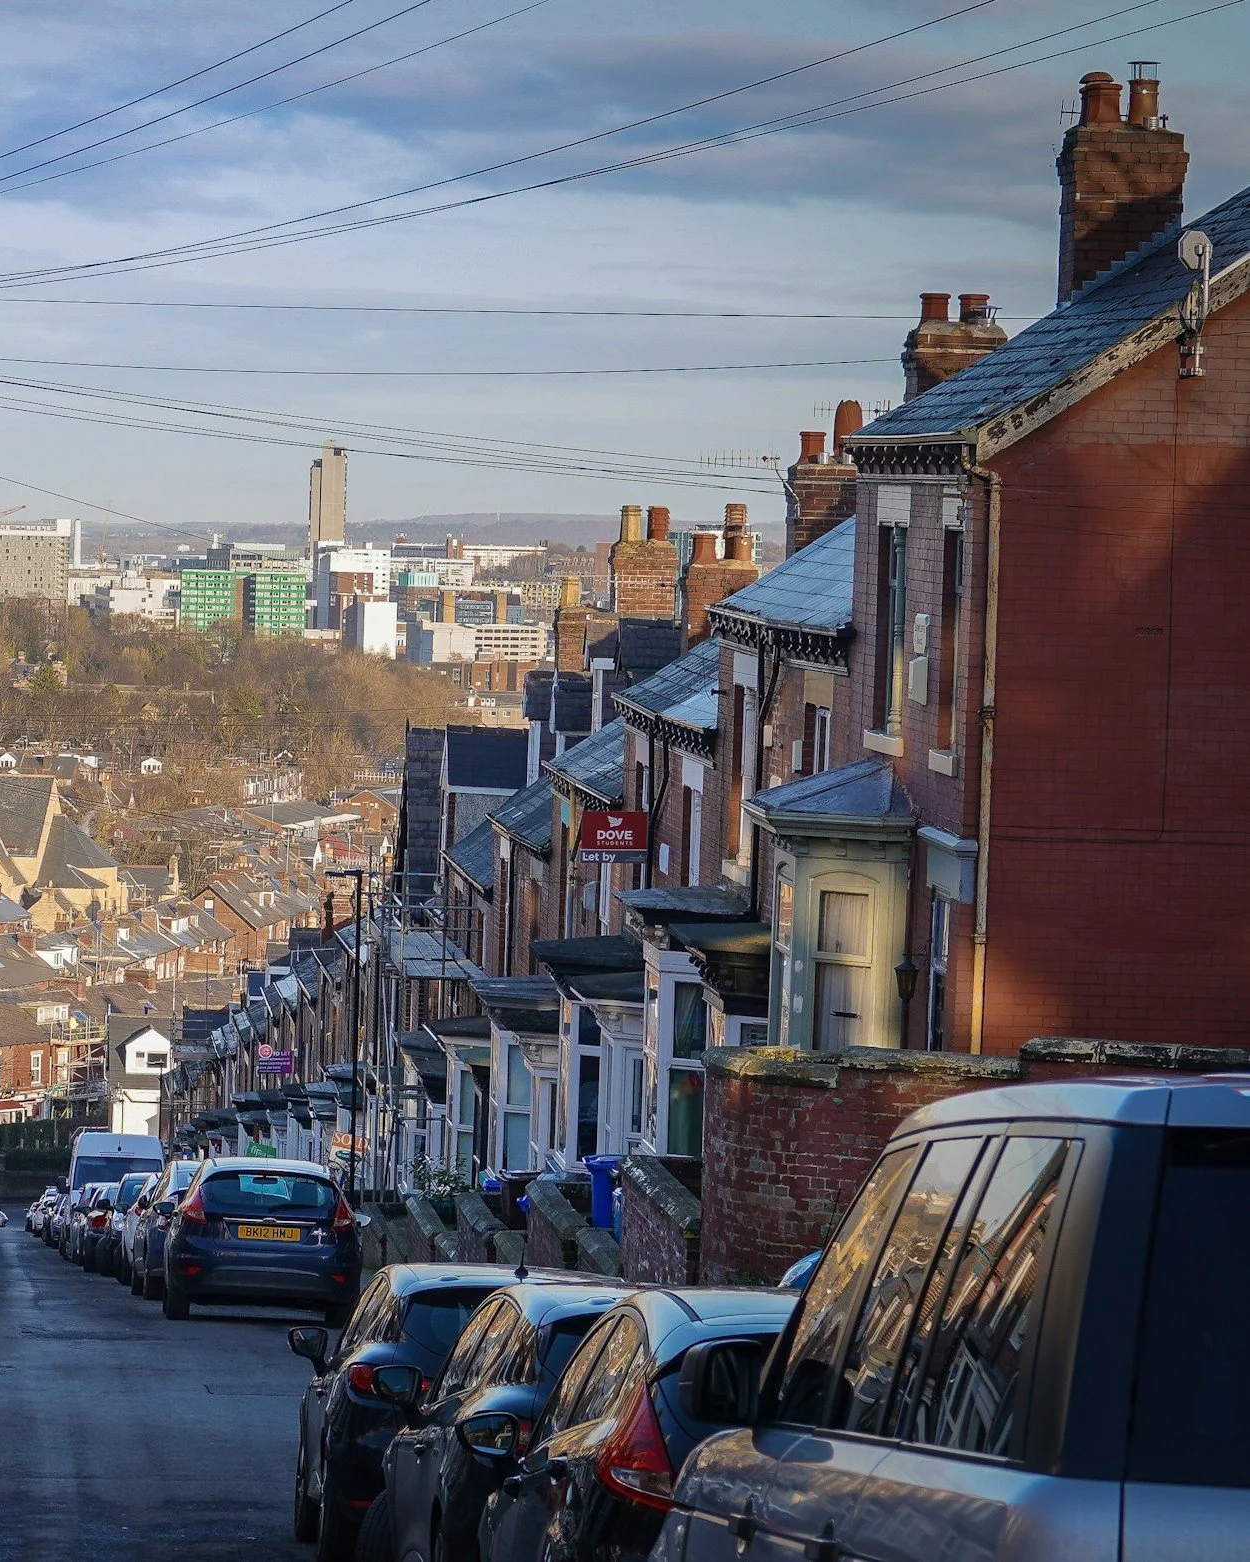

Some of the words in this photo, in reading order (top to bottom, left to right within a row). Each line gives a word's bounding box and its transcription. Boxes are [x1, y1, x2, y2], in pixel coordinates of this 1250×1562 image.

[596, 830, 633, 840] DOVE
[582, 852, 599, 861] Let
[603, 852, 616, 863] by
[334, 1132, 368, 1149] SOD
[245, 1227, 270, 1238] BK12
